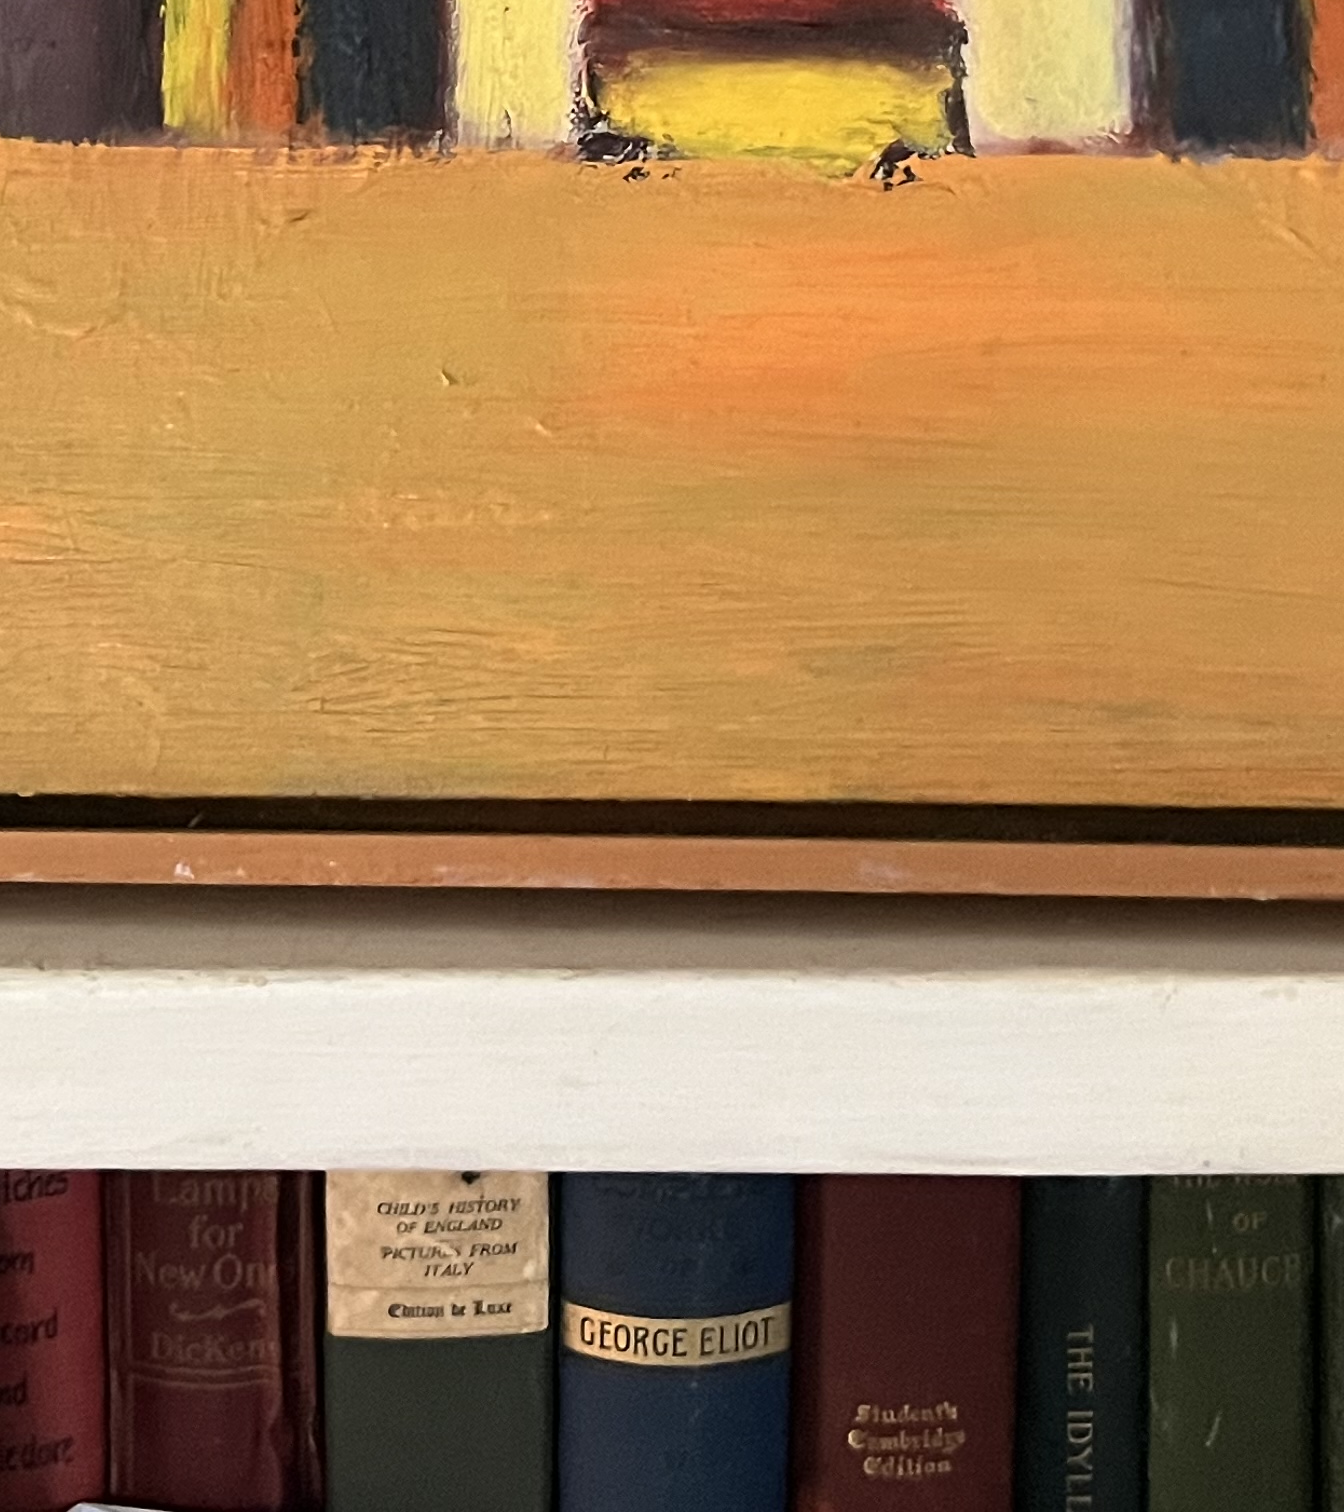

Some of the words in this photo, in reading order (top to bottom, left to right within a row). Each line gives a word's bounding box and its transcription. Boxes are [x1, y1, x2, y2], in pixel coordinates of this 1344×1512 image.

[377, 1200, 439, 1216] CHILD'S
[449, 1197, 522, 1215] HISTORY
[188, 1213, 244, 1249] for
[396, 1221, 417, 1235] OF
[424, 1217, 504, 1235] ENGLAND
[1232, 1212, 1268, 1233] OF
[469, 1242, 518, 1258] FROM
[133, 1250, 208, 1289] New
[424, 1261, 475, 1278] ITALY
[579, 1316, 688, 1359] GEORGE
[699, 1315, 776, 1357] ELIOT
[1065, 1324, 1095, 1394] THE
